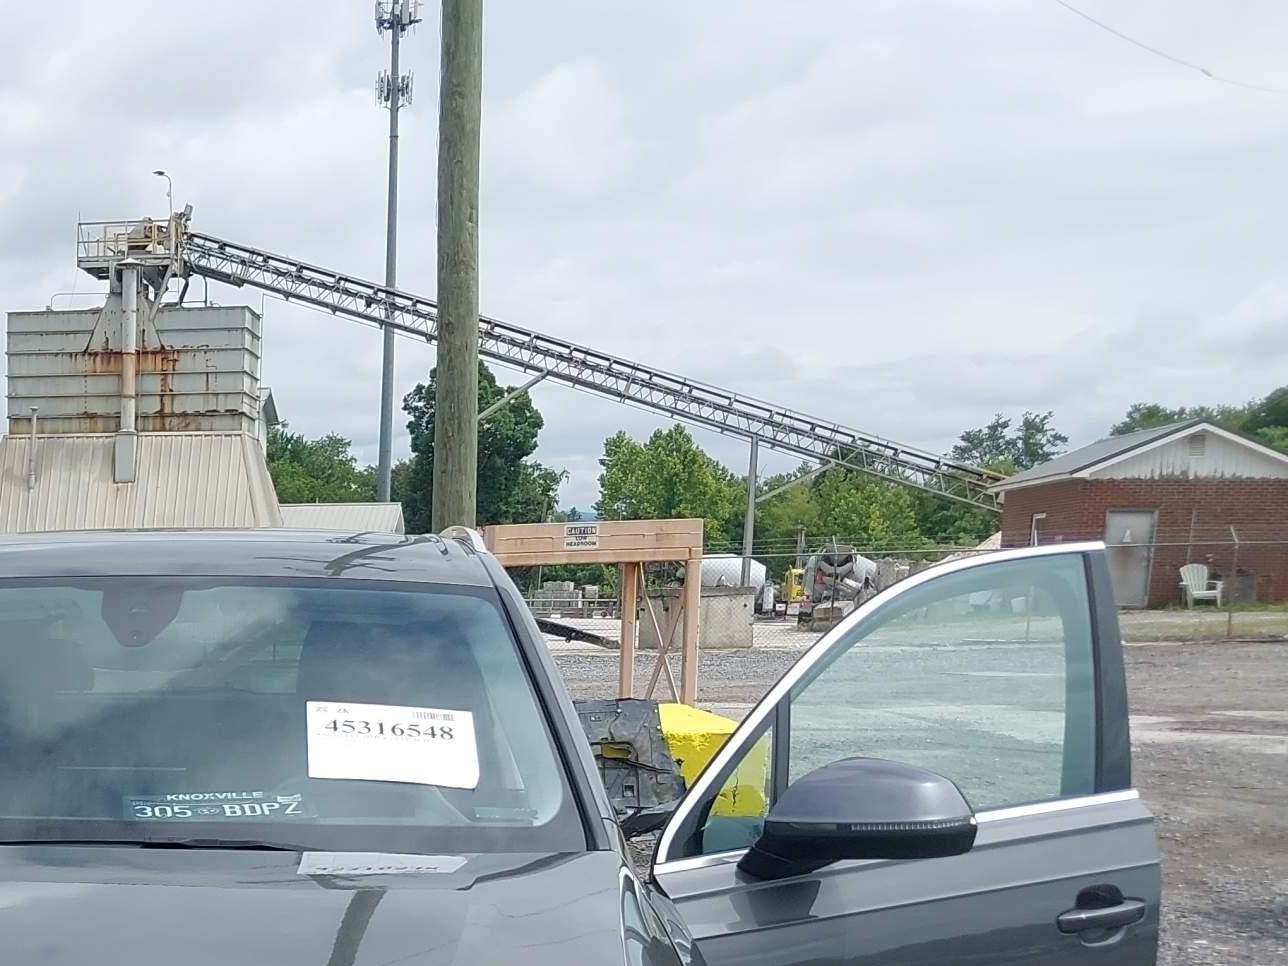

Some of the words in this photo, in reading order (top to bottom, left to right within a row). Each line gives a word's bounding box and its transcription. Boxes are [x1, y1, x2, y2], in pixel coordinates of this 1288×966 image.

[567, 527, 596, 535] CAUTION
[324, 719, 454, 740] 45316548
[166, 791, 265, 801] KNOXVILLE
[134, 804, 192, 818] 305
[222, 801, 303, 817] BDPZ
